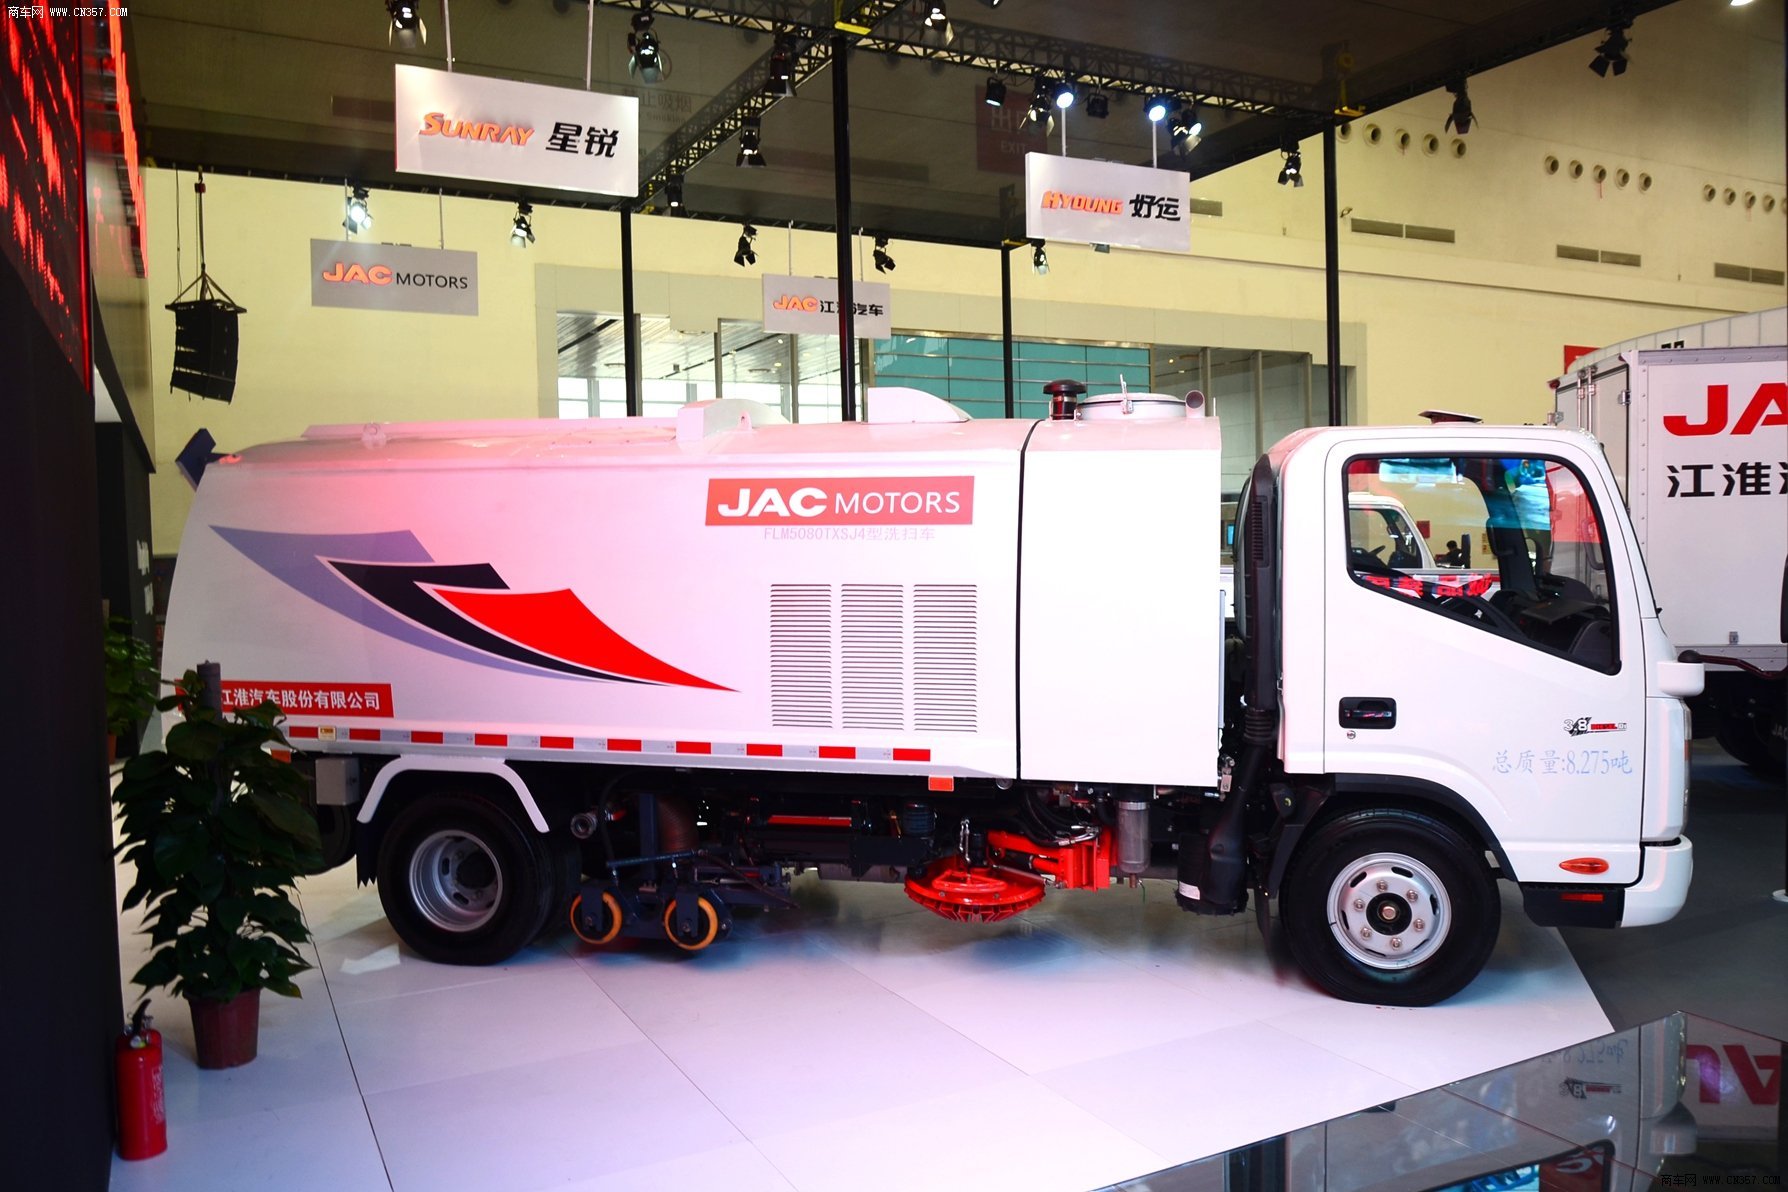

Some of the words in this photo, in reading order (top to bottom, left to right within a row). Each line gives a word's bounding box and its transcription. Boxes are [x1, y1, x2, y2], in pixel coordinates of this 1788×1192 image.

[546, 121, 619, 158] 星锐
[1001, 140, 1027, 155] EXIT
[1129, 193, 1181, 221] 好运
[323, 262, 393, 286] JAC
[396, 272, 468, 290] MOTORS
[773, 295, 819, 311] JAC
[820, 300, 884, 316] 江汽车
[718, 487, 828, 518] JAC
[834, 491, 961, 514] MOTORS
